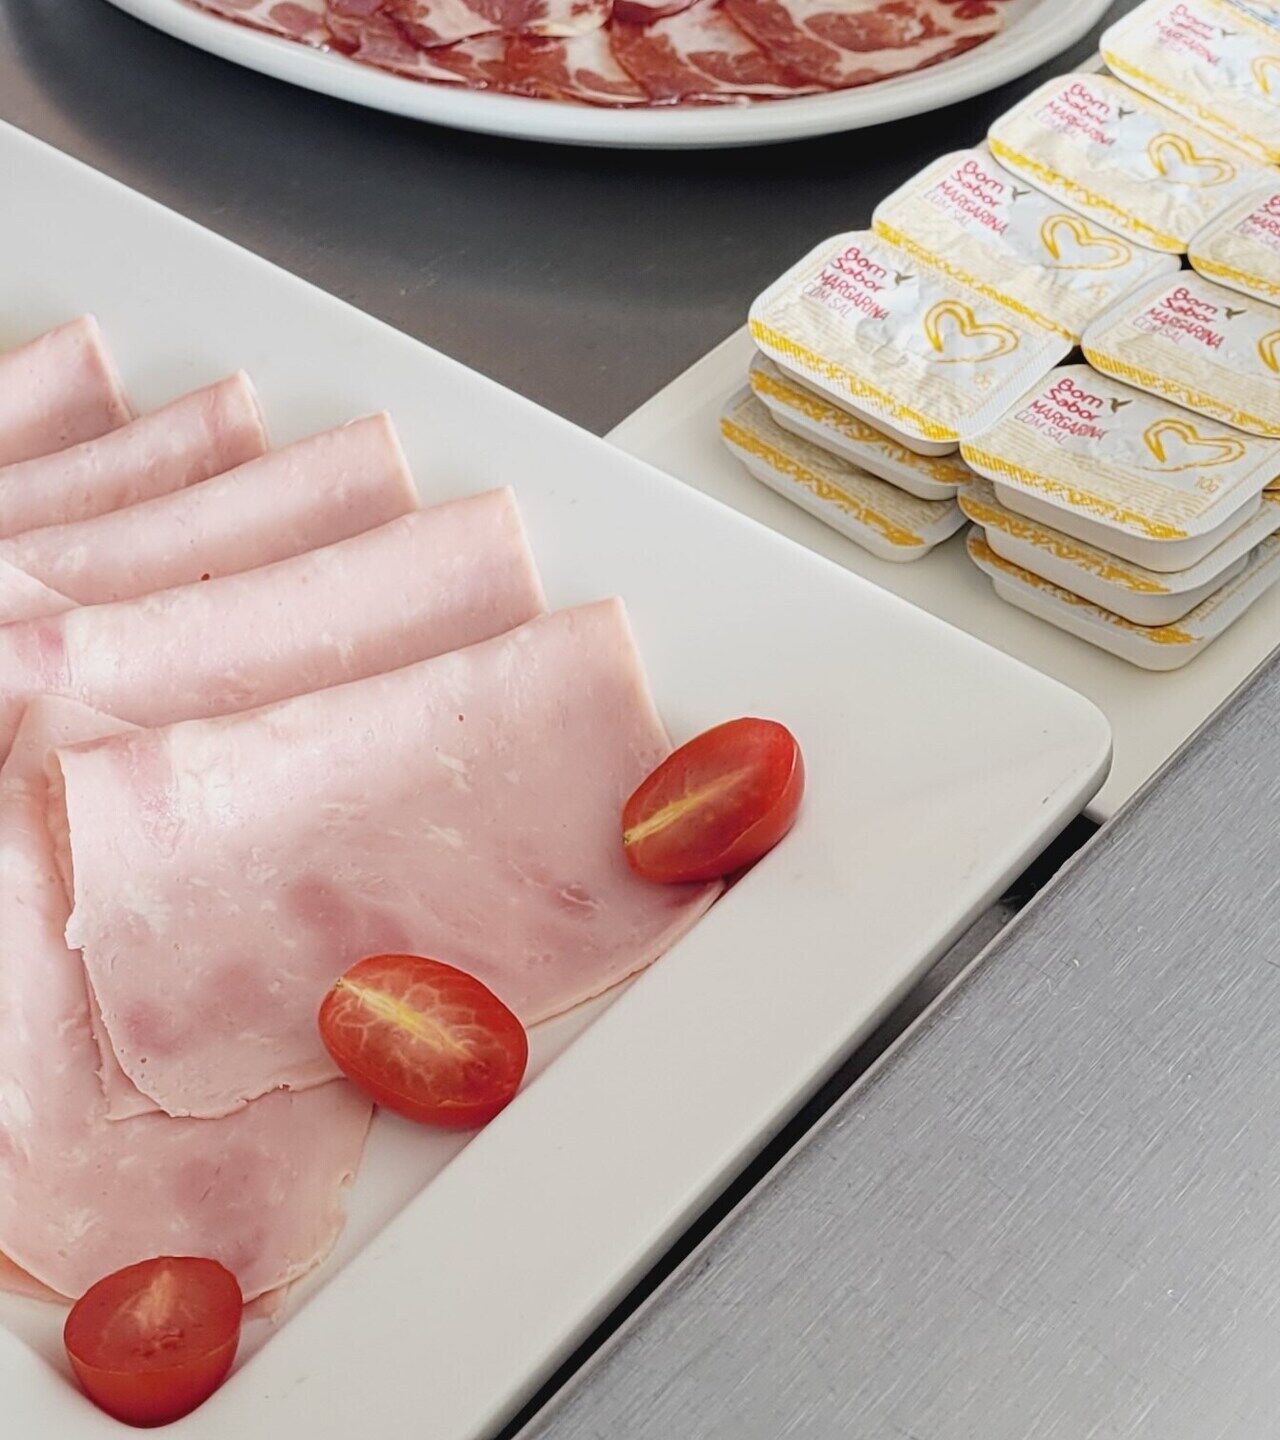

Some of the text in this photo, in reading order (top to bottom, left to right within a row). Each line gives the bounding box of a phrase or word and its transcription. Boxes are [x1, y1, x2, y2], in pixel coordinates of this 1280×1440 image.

[951, 169, 1003, 208] Sabor
[963, 160, 1005, 194] Bom
[830, 257, 885, 292] Sabor
[844, 246, 887, 279] Bom
[815, 269, 890, 321] MARGARINA
[1160, 297, 1217, 324] Sabor
[1173, 287, 1218, 314] Bom
[1043, 388, 1101, 422] Sabor
[1057, 377, 1104, 410] Bom
